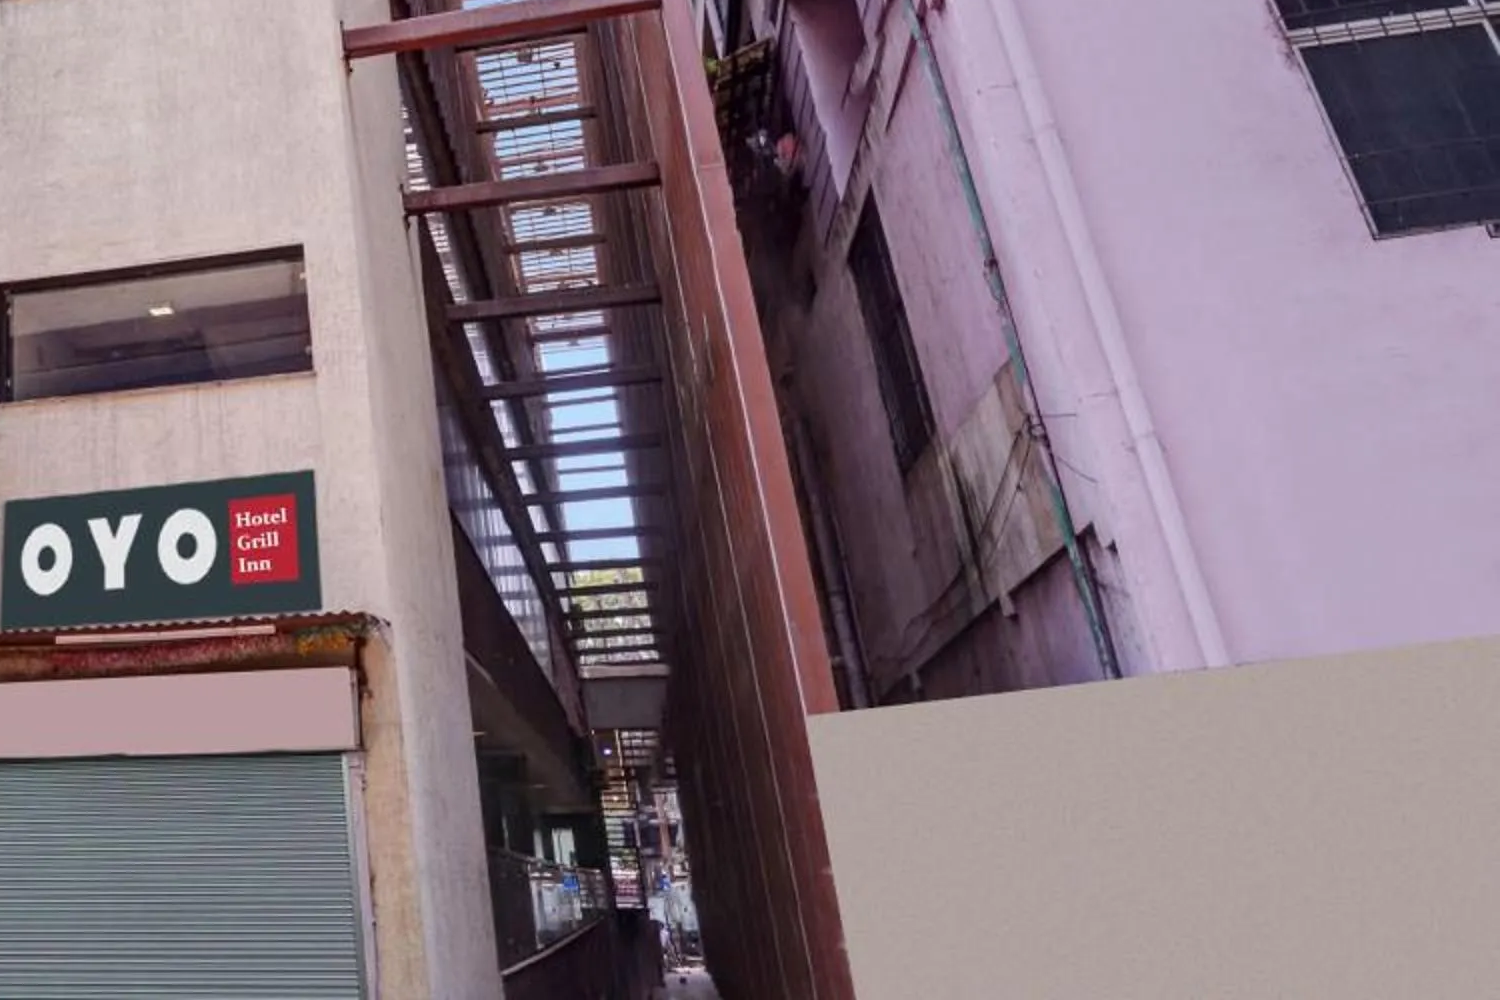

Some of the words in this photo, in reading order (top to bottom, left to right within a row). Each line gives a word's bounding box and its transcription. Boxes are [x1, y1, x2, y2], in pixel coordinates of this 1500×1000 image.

[236, 508, 287, 527] Hotel
[237, 532, 279, 551] Grill
[21, 508, 217, 595] OYO
[239, 557, 272, 573] Inn
